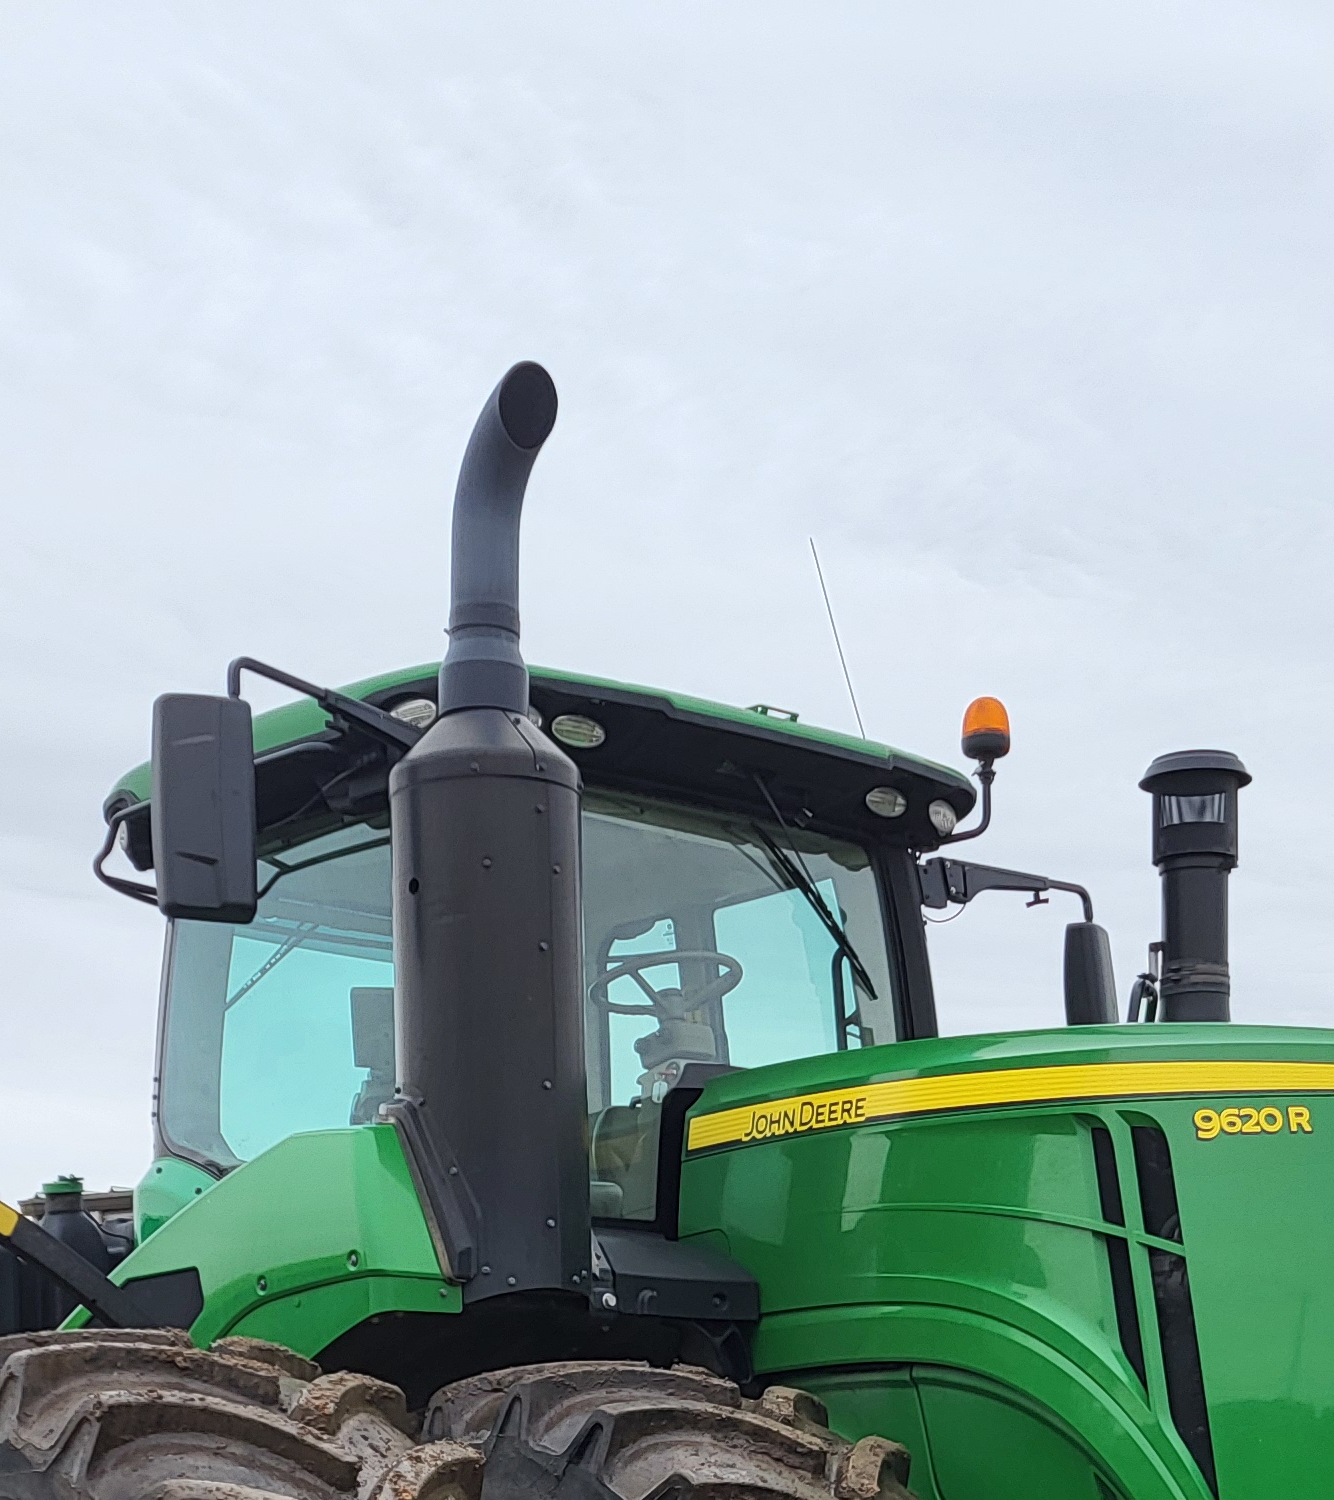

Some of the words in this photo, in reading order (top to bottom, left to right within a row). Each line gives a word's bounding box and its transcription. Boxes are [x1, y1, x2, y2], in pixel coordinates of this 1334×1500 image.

[742, 1109, 796, 1139] JOHN
[797, 1097, 867, 1129] DEERE
[1193, 1106, 1284, 1140] 9620
[1286, 1104, 1314, 1134] R
